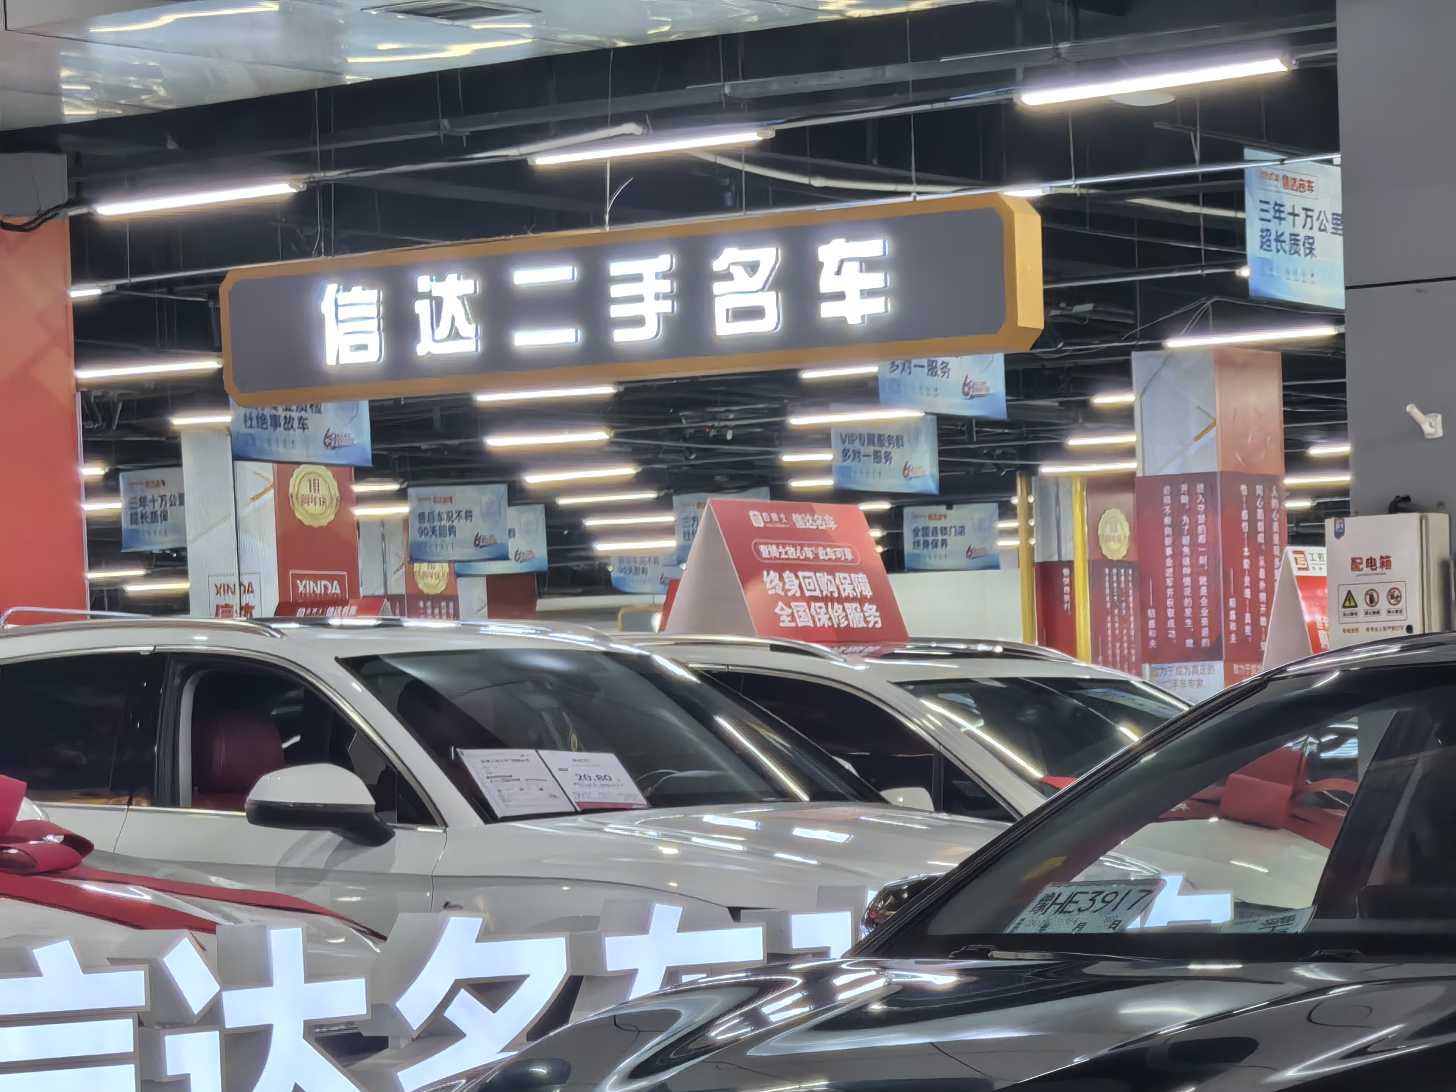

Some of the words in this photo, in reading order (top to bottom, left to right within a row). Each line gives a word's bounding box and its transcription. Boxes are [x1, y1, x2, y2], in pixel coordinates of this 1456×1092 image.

[1259, 228, 1317, 259] 超长质保
[321, 238, 891, 366] 信达二手名车
[243, 413, 309, 432] 杜绝事故车
[1350, 555, 1392, 572] 配电箱
[296, 579, 341, 594] XINDA
[763, 570, 872, 598] 终身回购保障
[774, 602, 882, 628] 全国保修服务
